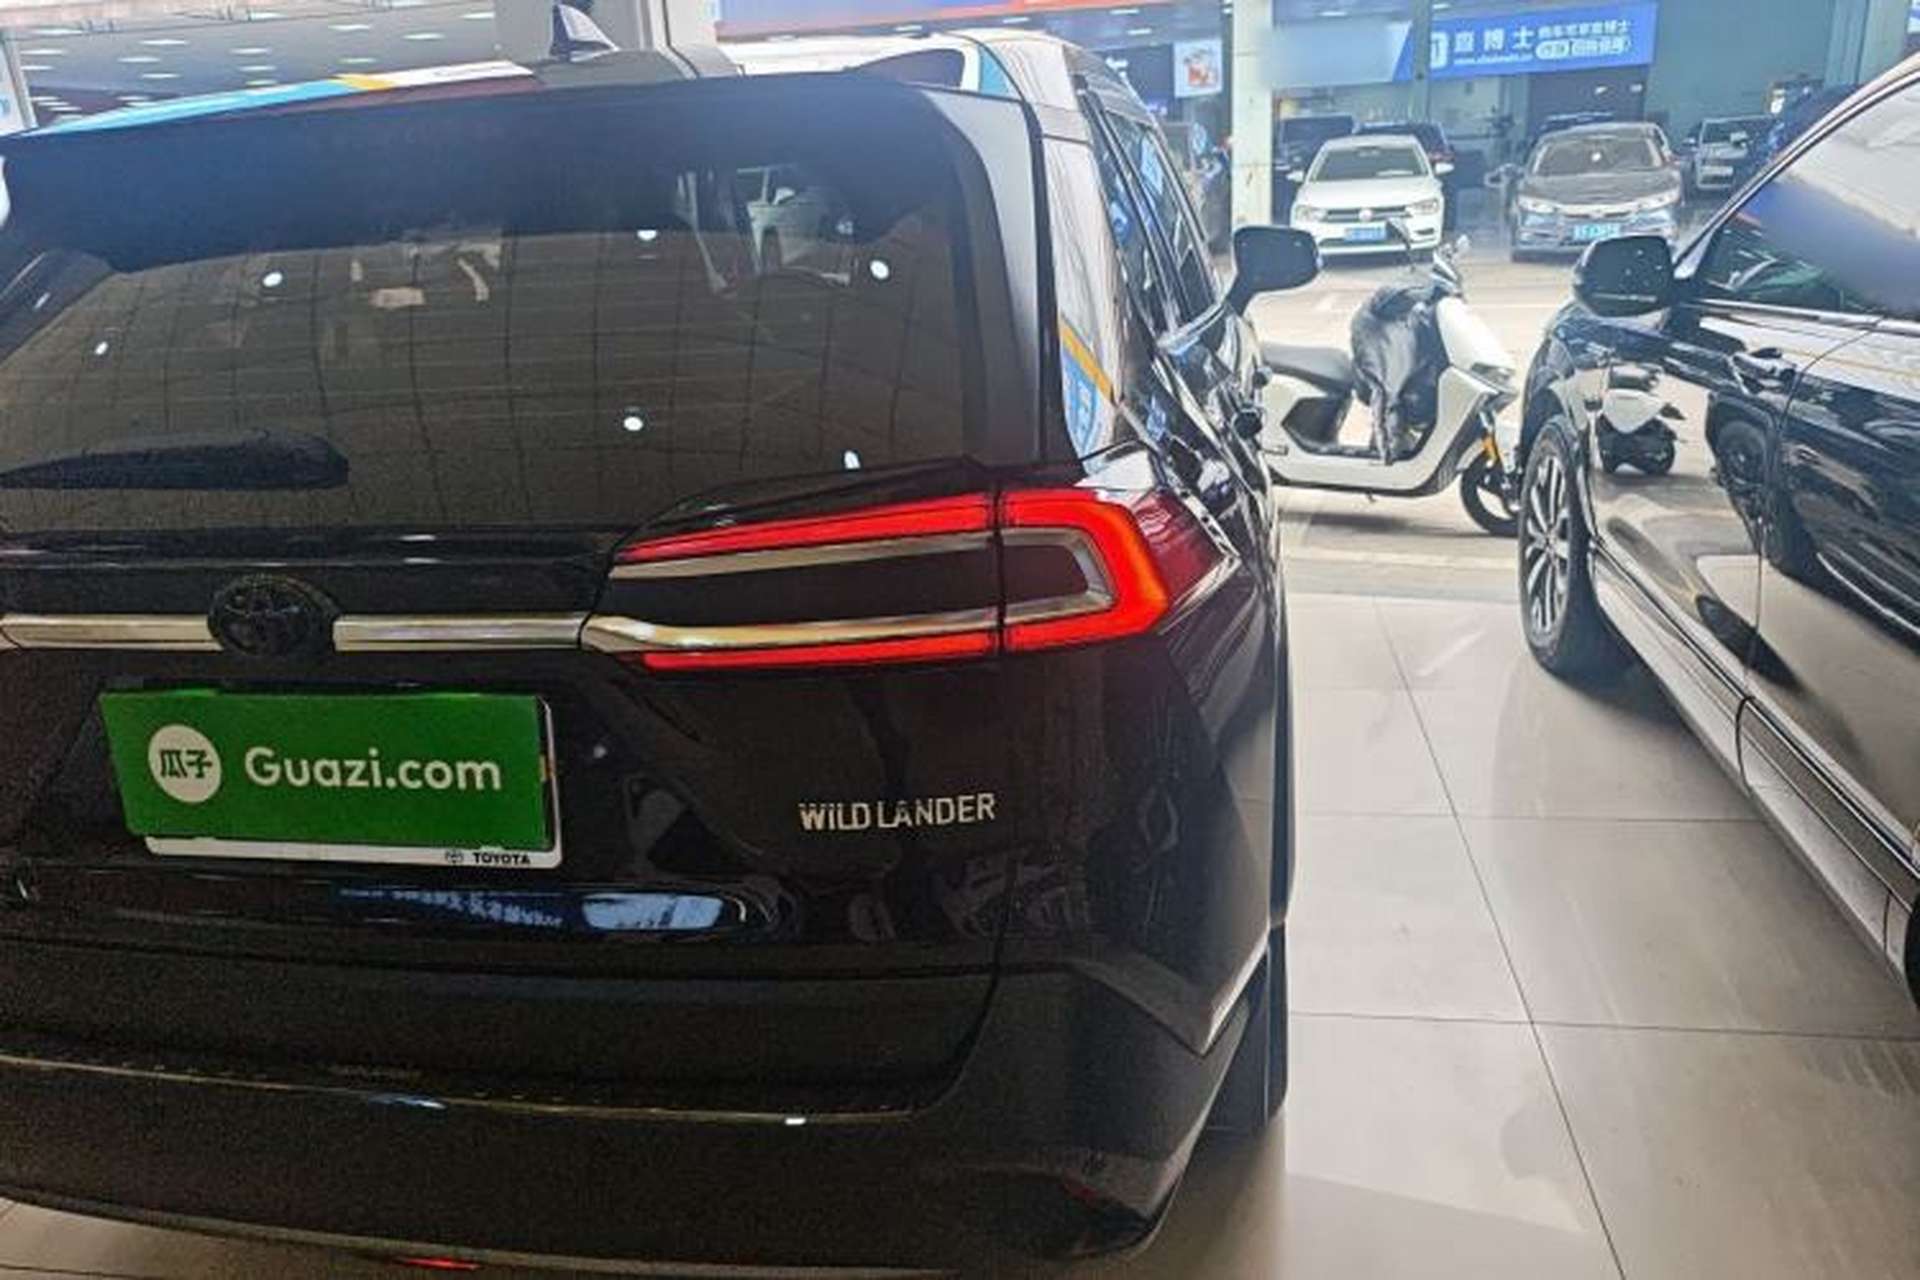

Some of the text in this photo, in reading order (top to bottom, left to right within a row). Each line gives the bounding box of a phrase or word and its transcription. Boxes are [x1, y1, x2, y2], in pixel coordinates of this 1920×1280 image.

[159, 748, 213, 781] 瓜子
[244, 746, 502, 791] Guazi.com
[473, 852, 531, 864] TOYOTA
